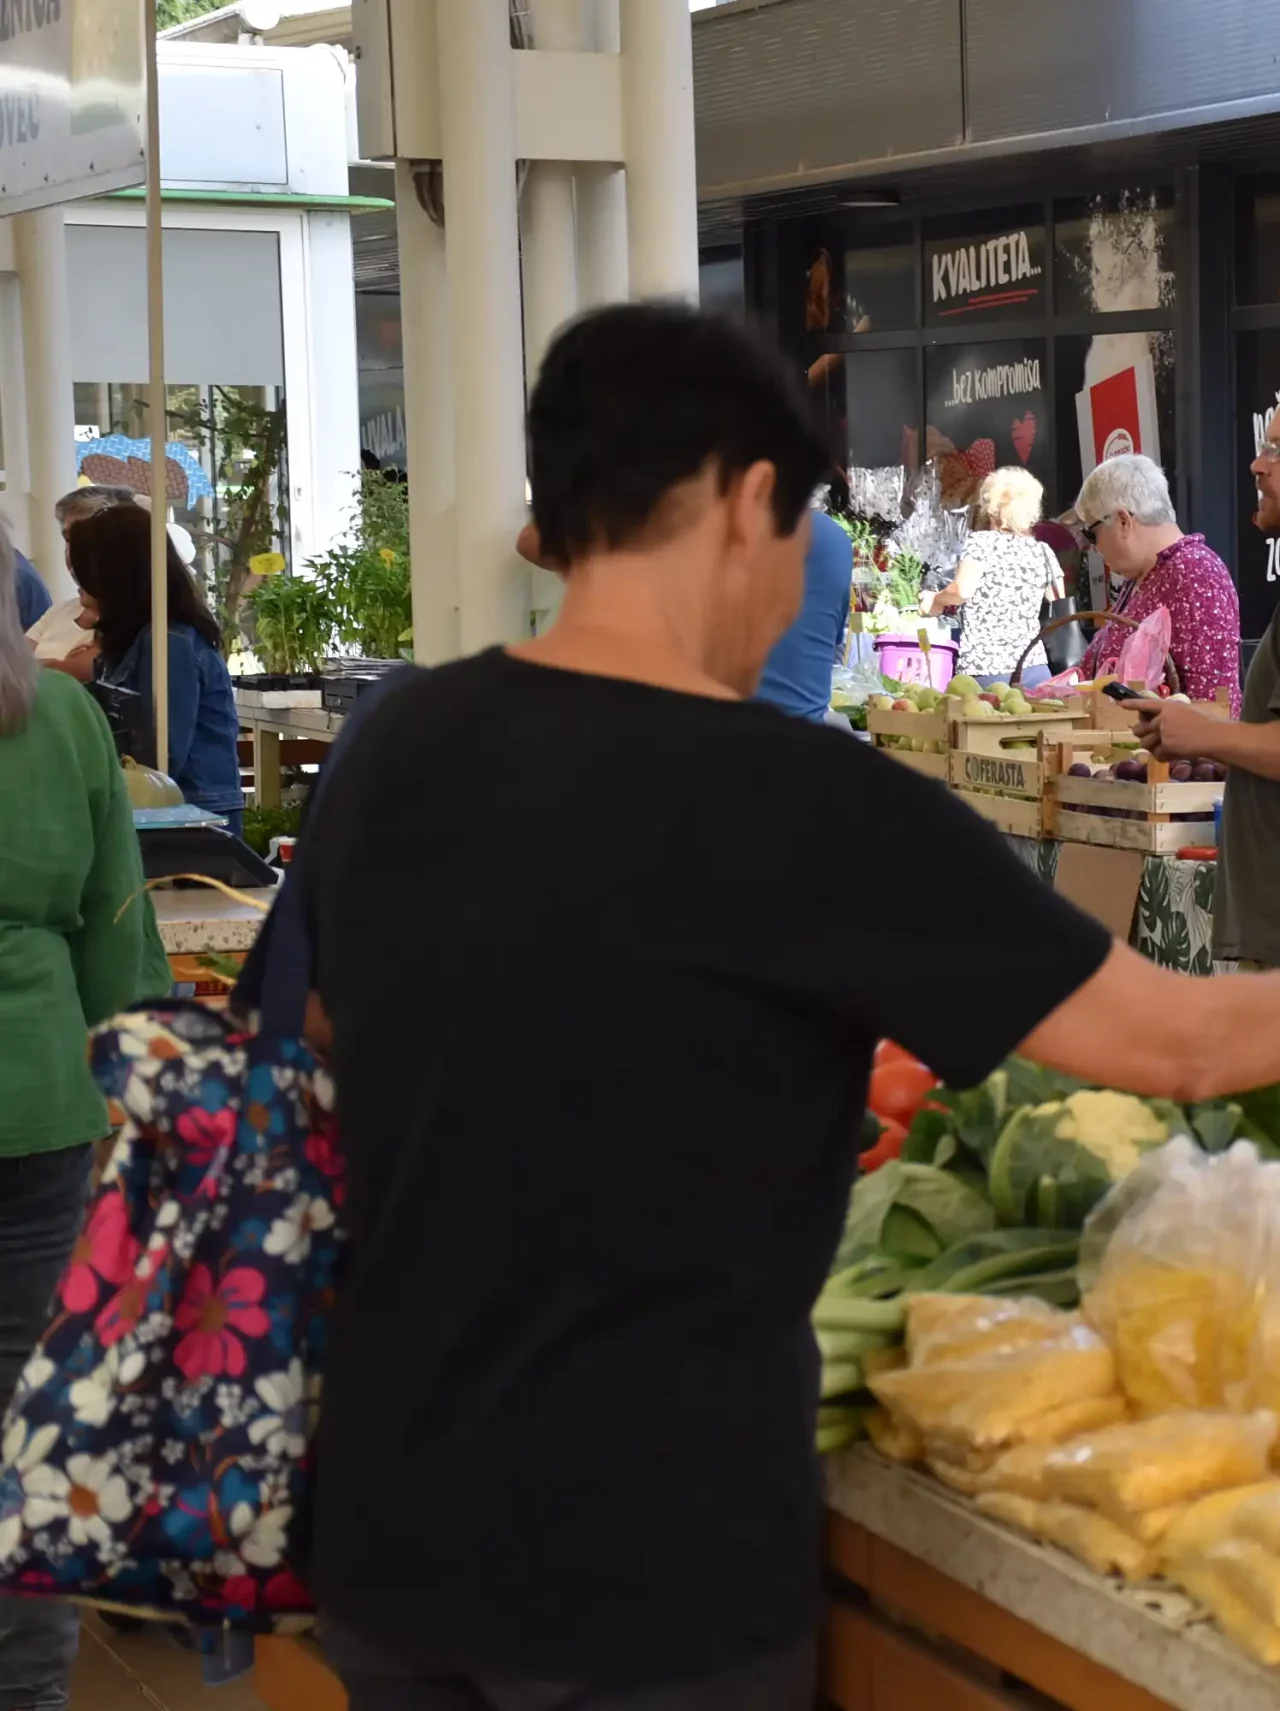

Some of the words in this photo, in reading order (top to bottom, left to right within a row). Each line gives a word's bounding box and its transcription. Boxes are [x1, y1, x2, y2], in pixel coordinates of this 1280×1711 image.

[0, 90, 40, 149] VEC
[932, 231, 1042, 302] KVALITETA...
[965, 755, 1026, 789] COFERASTA
